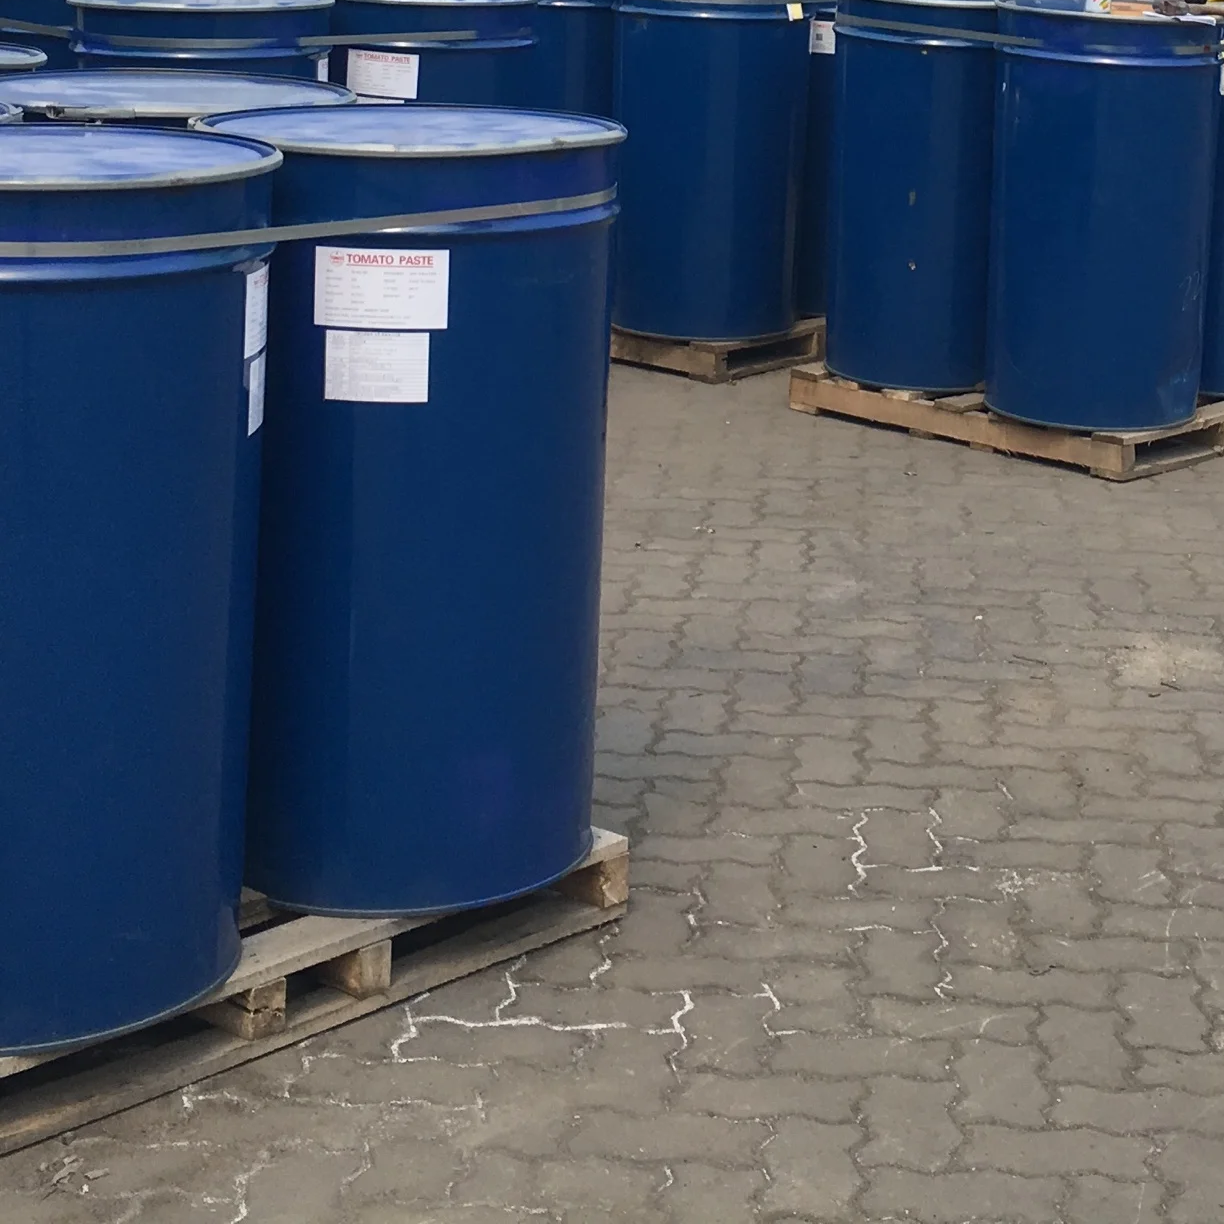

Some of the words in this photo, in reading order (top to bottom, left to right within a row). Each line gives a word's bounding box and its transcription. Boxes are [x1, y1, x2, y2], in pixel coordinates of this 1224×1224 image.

[364, 53, 389, 61] TOMATO
[391, 56, 410, 64] PASTE
[346, 253, 394, 265] TOMATO
[400, 255, 434, 266] PASTE
